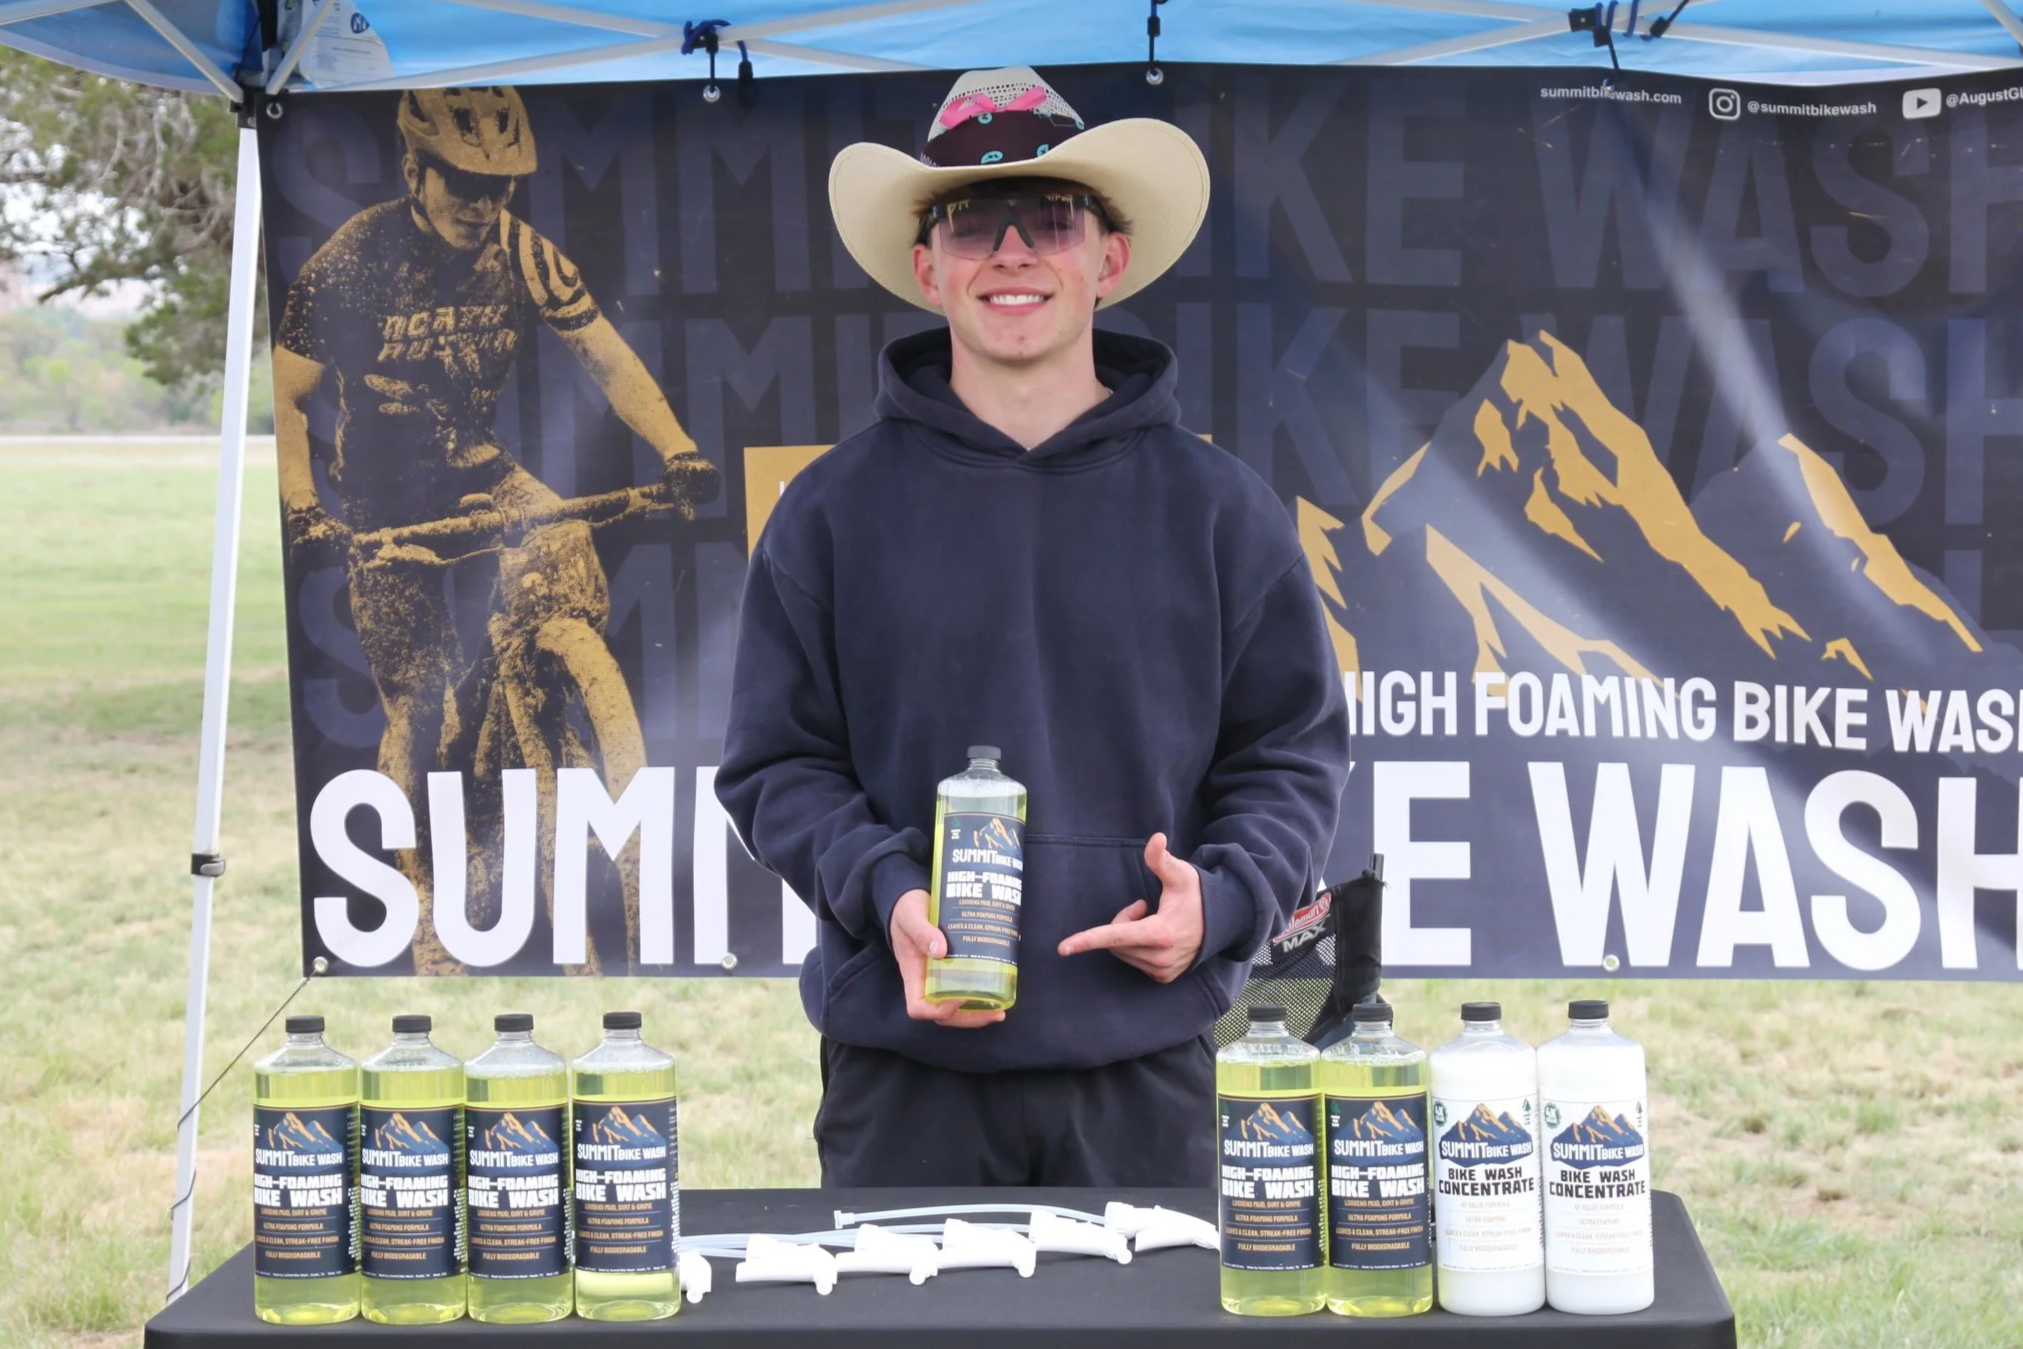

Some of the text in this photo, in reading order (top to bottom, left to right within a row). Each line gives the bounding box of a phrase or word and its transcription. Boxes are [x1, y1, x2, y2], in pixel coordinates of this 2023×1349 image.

[1747, 101, 1877, 116] @summitbikewash
[1475, 671, 1717, 741] FOAMING
[1733, 681, 1868, 750] BIKE
[1886, 689, 2023, 754] WAS
[1528, 761, 2023, 970] WASH
[946, 883, 983, 898] BIKE
[1282, 921, 1326, 953] MAX
[1291, 1143, 1314, 1156] WASH
[316, 1152, 342, 1166] WASH
[423, 1153, 449, 1166] WASH
[534, 1152, 558, 1166] WASH
[1331, 1162, 1424, 1180] HIGH-FOAMING
[1448, 1166, 1522, 1180] BIKE WASH
[1560, 1168, 1635, 1183] BIKE WASH
[576, 1182, 666, 1202] BIKE WASH
[1222, 1178, 1314, 1198] BIKE WASH
[1332, 1176, 1424, 1198] BIKE WASH
[1439, 1178, 1534, 1196] CONCENTRATE
[1550, 1180, 1646, 1198] CONCENTRATE
[255, 1187, 342, 1207] BIKE WASH
[360, 1187, 449, 1208] BIKE WASH
[468, 1188, 559, 1208] BIKE WASH
